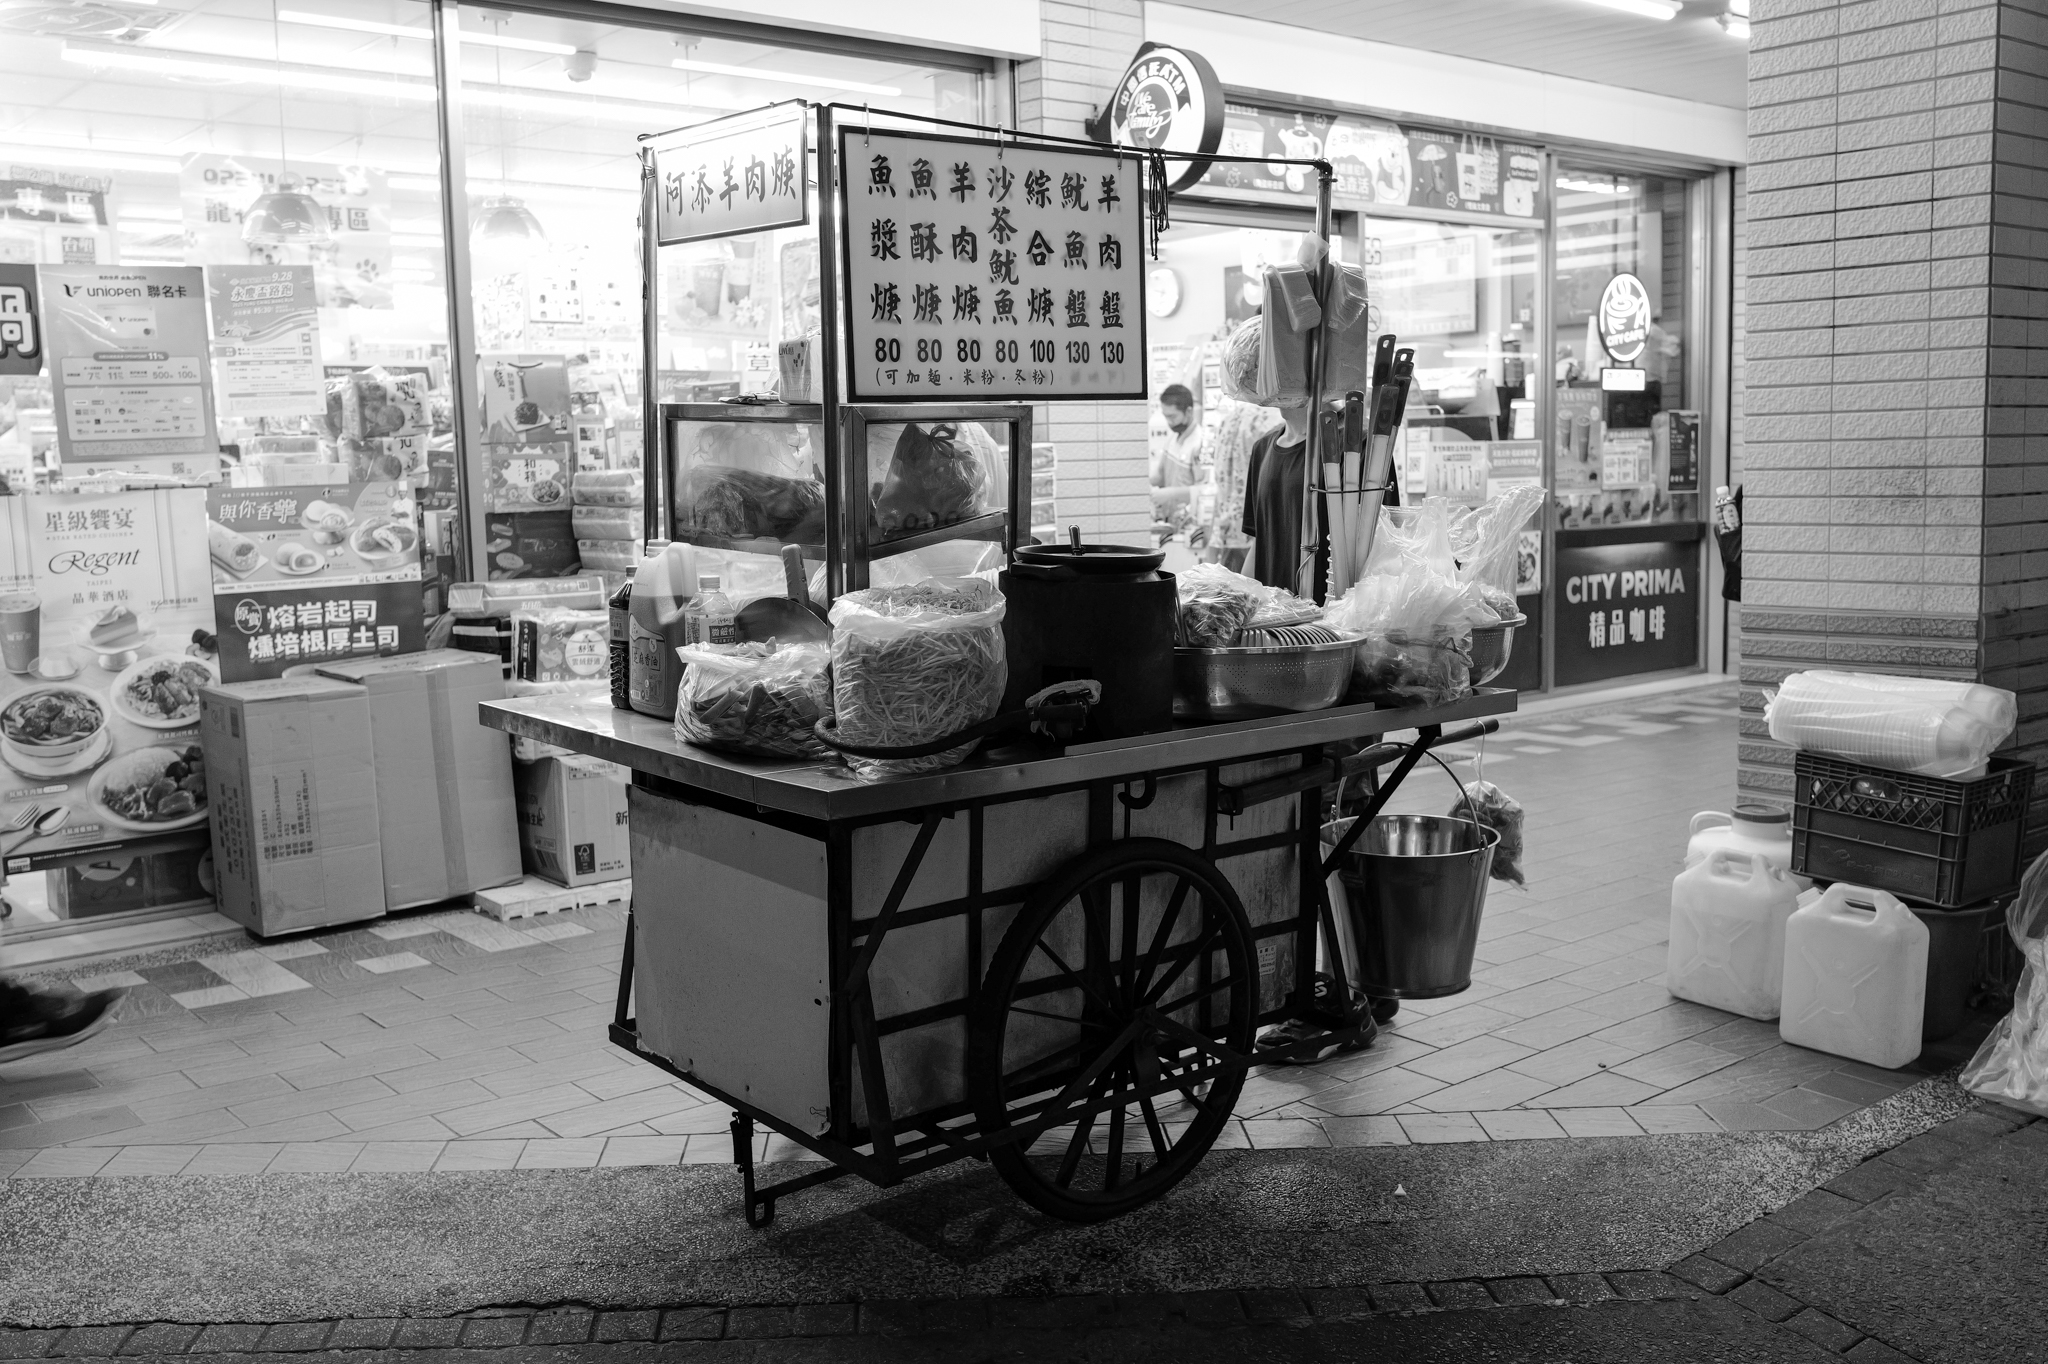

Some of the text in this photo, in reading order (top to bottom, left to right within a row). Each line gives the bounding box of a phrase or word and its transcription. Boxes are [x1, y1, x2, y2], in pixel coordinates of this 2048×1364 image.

[1332, 174, 1370, 195] 色森活
[987, 165, 1020, 326] 沙茶魷魚
[1060, 171, 1090, 329] 魷魚盤
[1097, 174, 1124, 329] 羊肉盤
[271, 271, 293, 282] 9.28
[87, 285, 187, 299] uniopen 聯名卡
[875, 337, 1125, 364] 80 80 80 80 100 130 130
[1606, 328, 1645, 347] CITY CAFE
[44, 506, 135, 534] 星級饗宴
[48, 548, 142, 576] Regent
[86, 579, 113, 587] TAIPEI
[1566, 567, 1686, 604] CITY PRIMA
[267, 600, 377, 630] 熔岩起司
[1588, 605, 1666, 649] 精品咖啡
[248, 624, 399, 660] 燻培根厚土司
[633, 651, 659, 667] 芝麻香油
